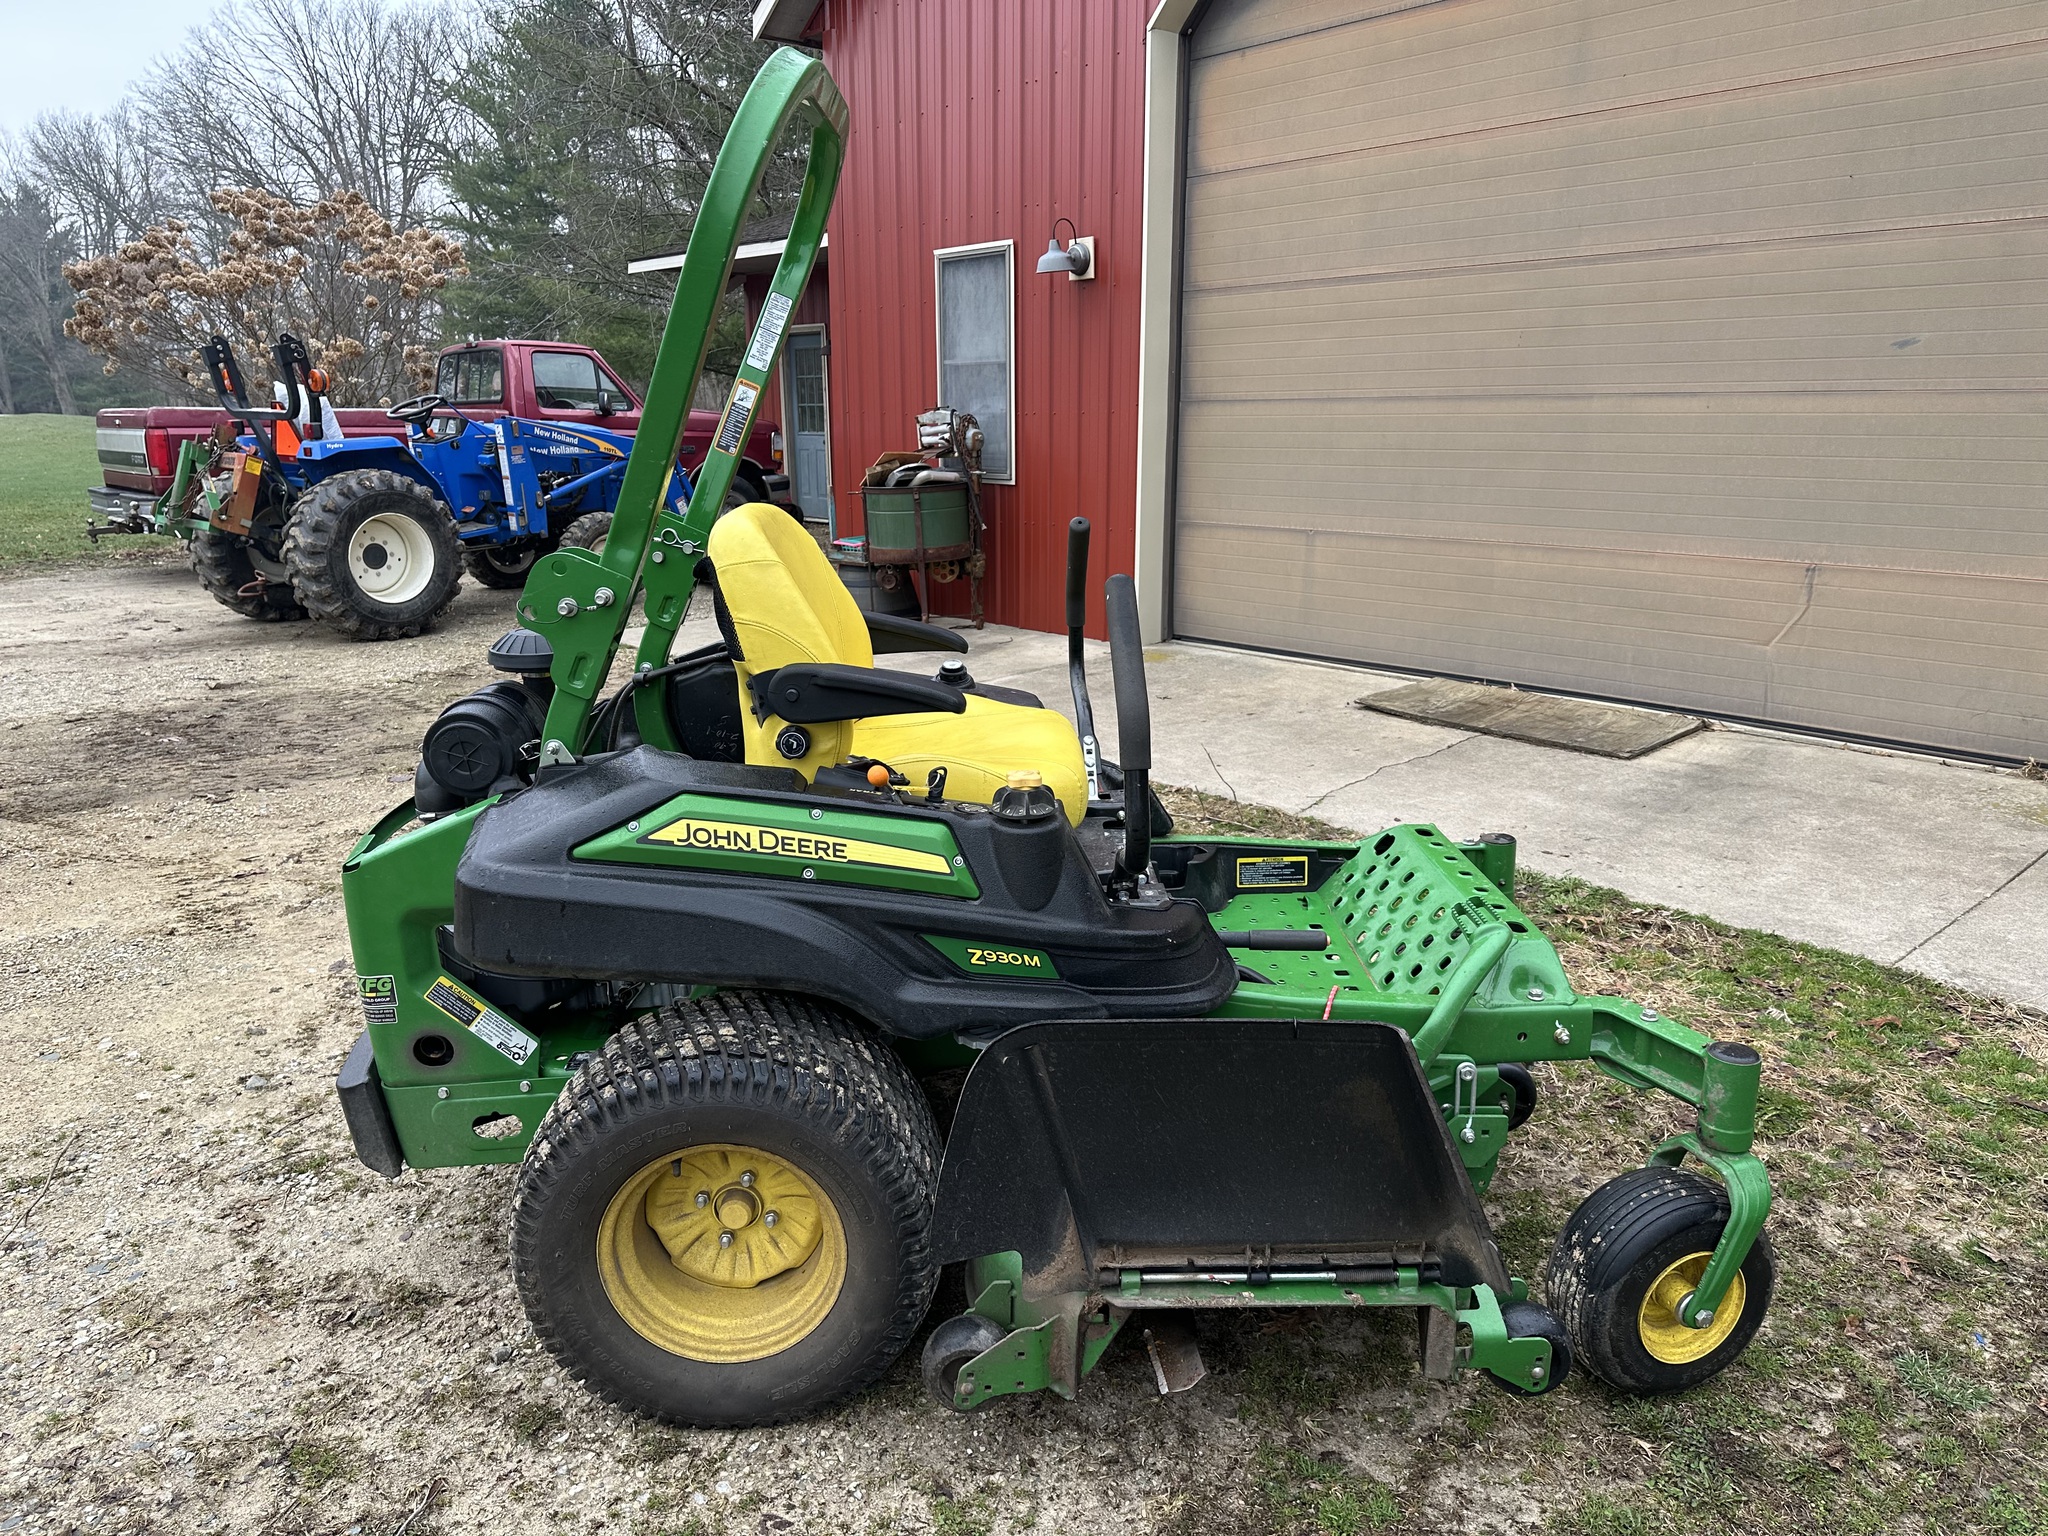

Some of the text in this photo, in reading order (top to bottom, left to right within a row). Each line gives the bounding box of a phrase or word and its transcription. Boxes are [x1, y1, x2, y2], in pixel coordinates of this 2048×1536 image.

[534, 426, 579, 445] New Holland
[326, 442, 344, 450] Hydro
[677, 823, 848, 859] JOHN DEERE
[967, 948, 1041, 967] Z930M
[358, 977, 392, 992] KFG
[452, 986, 476, 1006] CAUTION
[597, 1121, 687, 1171] MASTER
[771, 1329, 861, 1401] CARLISLE
